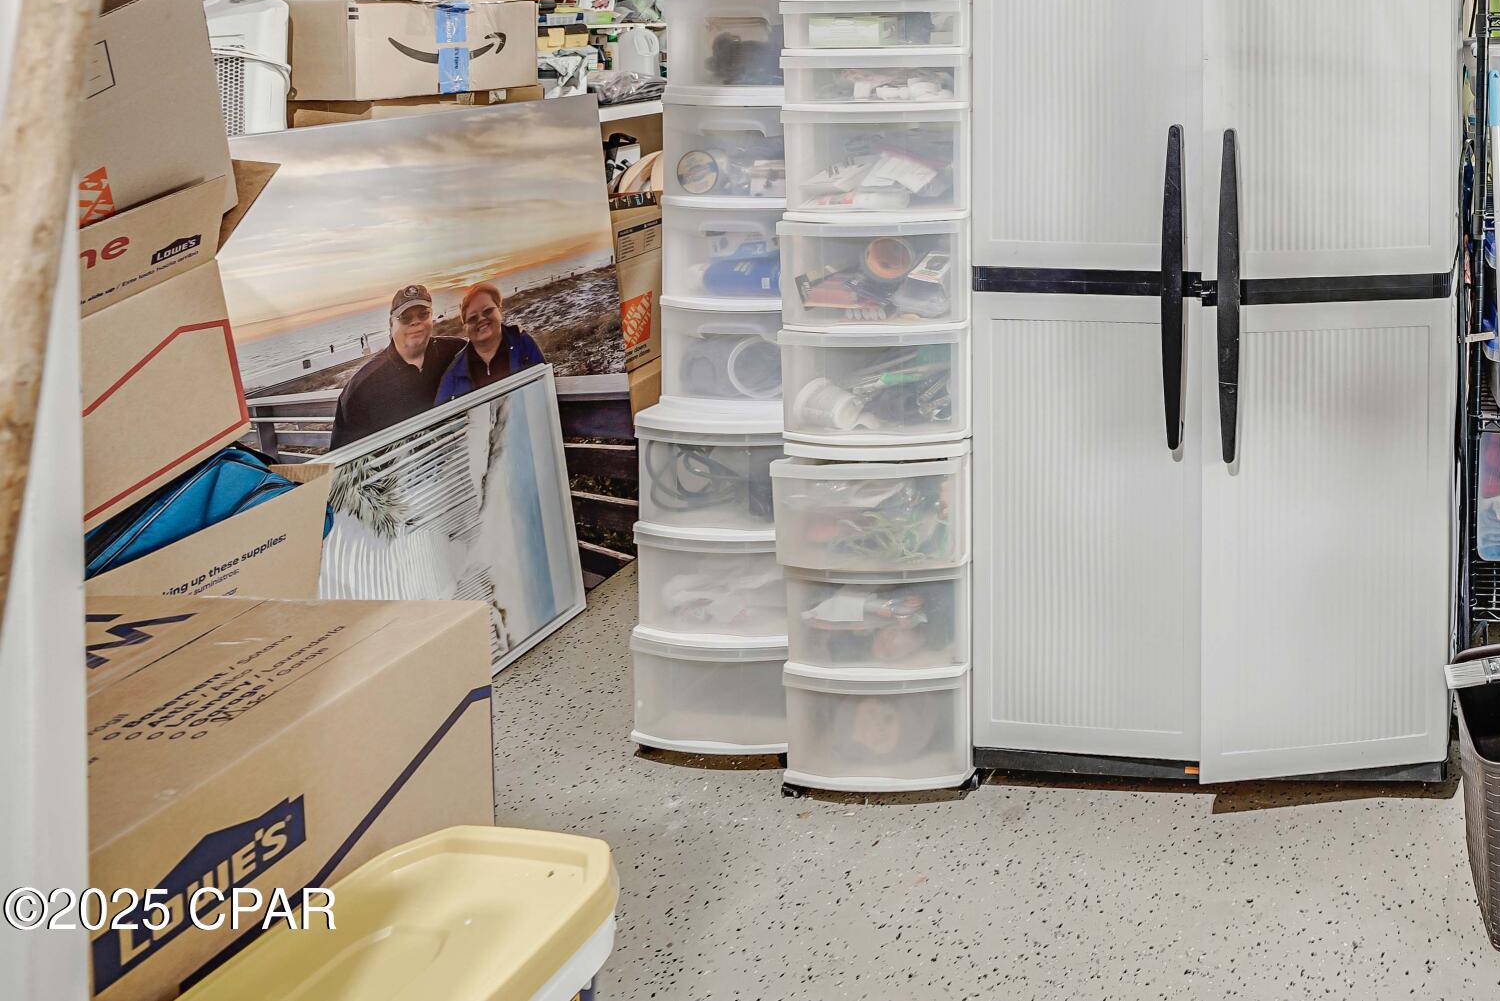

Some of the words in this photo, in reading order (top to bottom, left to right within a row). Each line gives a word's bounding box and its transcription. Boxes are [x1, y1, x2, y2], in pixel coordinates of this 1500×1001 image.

[156, 238, 197, 261] LOWE'S
[190, 574, 206, 588] up
[208, 557, 240, 576] these
[241, 533, 287, 562] supplies:
[122, 672, 229, 728] Basement
[147, 699, 200, 728] Attic
[165, 680, 253, 728] Laundry
[188, 684, 266, 728] Garage
[117, 818, 289, 967] LOWE'S
